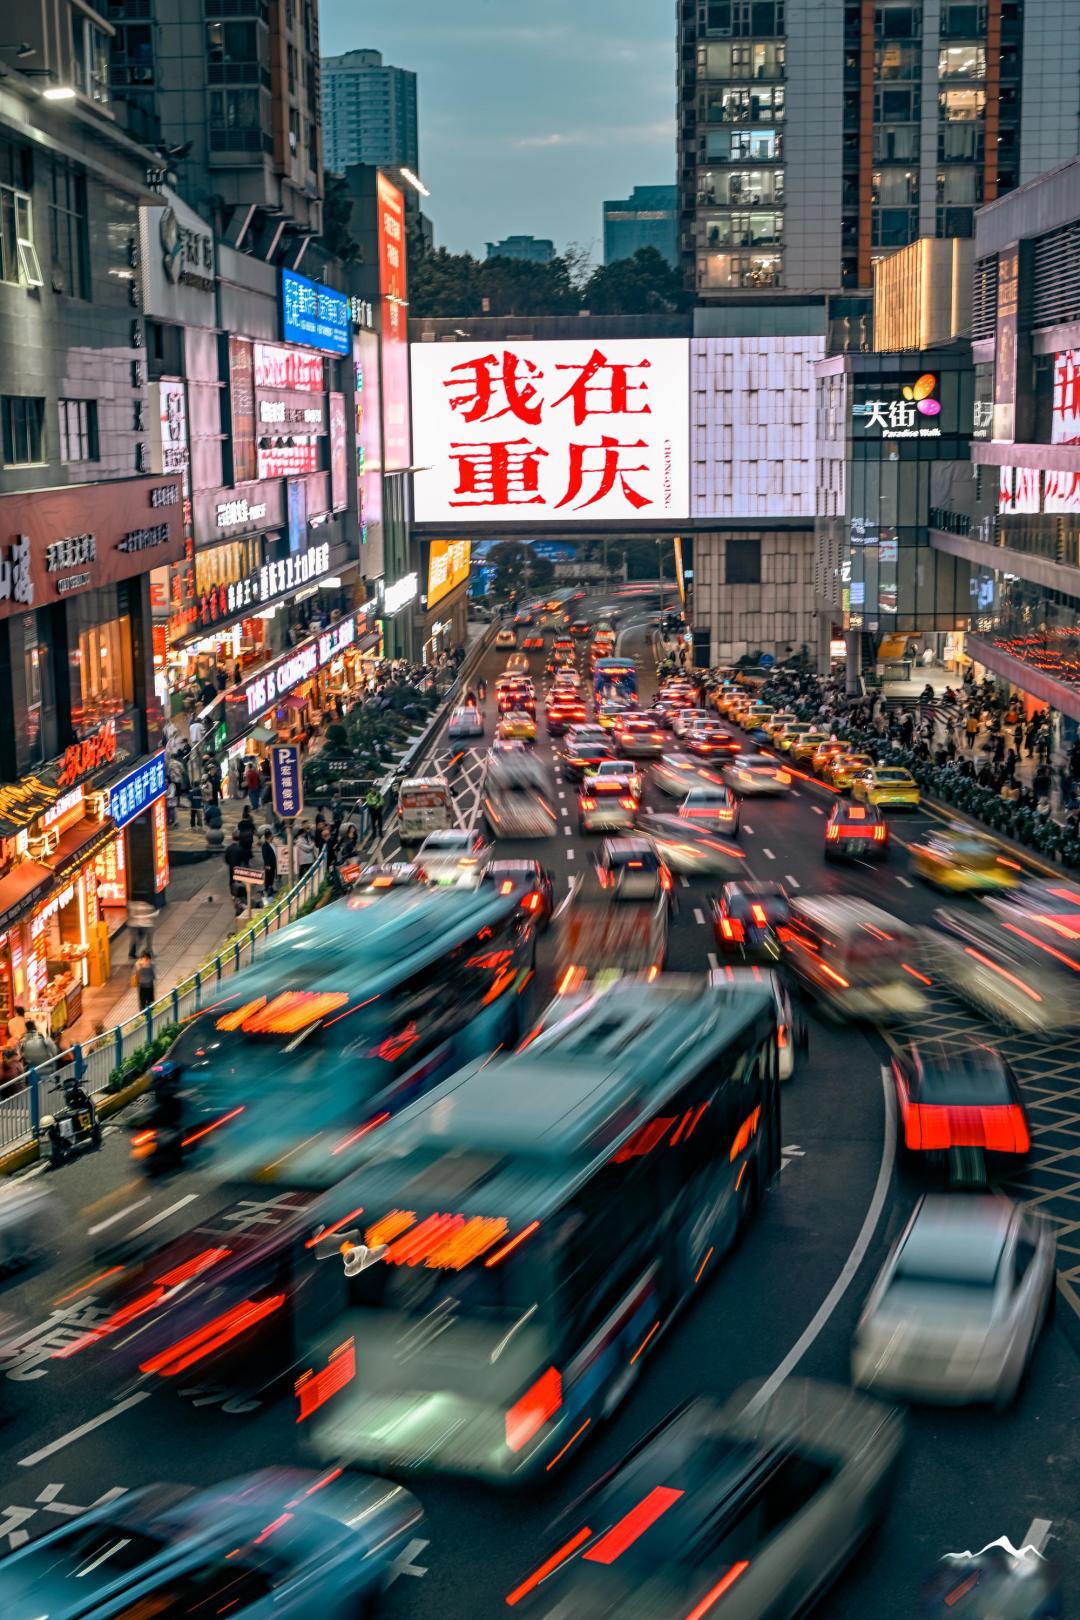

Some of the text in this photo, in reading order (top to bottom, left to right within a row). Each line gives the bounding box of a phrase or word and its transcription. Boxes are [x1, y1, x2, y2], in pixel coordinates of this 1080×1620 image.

[443, 349, 652, 426] 我在
[864, 400, 916, 428] 天街
[882, 428, 919, 438] Paradise
[448, 435, 654, 510] 重庆
[663, 438, 672, 510] CHONGQING
[279, 749, 292, 765] P
